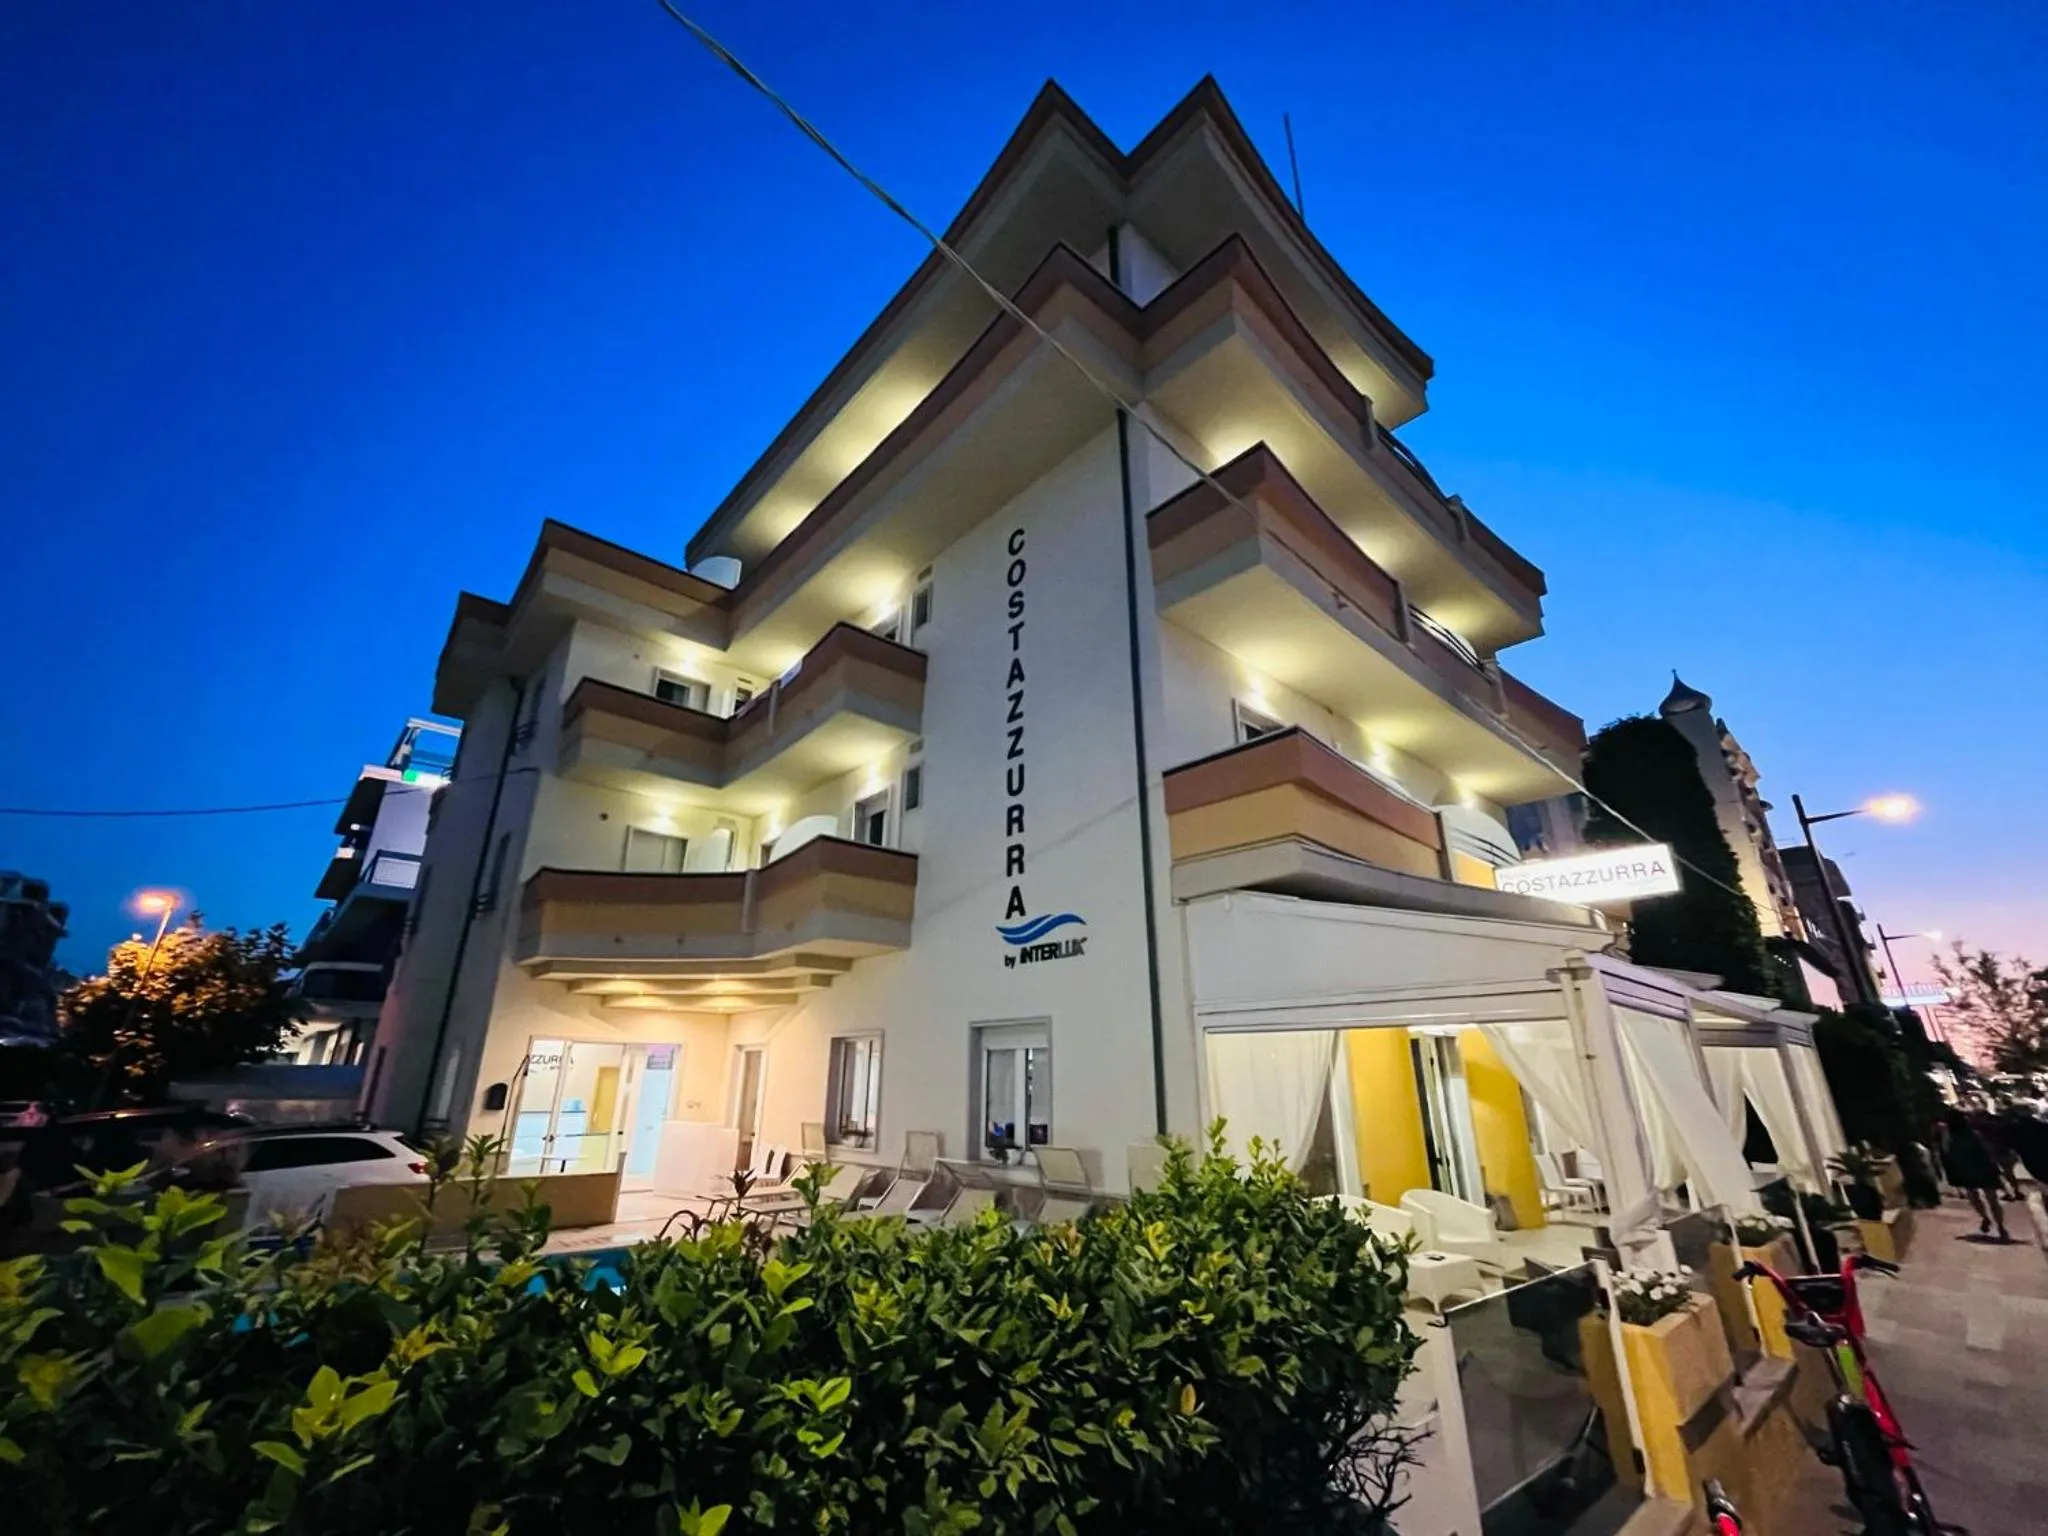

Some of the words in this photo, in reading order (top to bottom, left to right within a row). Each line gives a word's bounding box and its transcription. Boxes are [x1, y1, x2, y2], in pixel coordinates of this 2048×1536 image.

[1005, 528, 1026, 920] COSTAZZURRA
[1502, 860, 1667, 894] COSTAZZURRA
[1004, 954, 1017, 969] by
